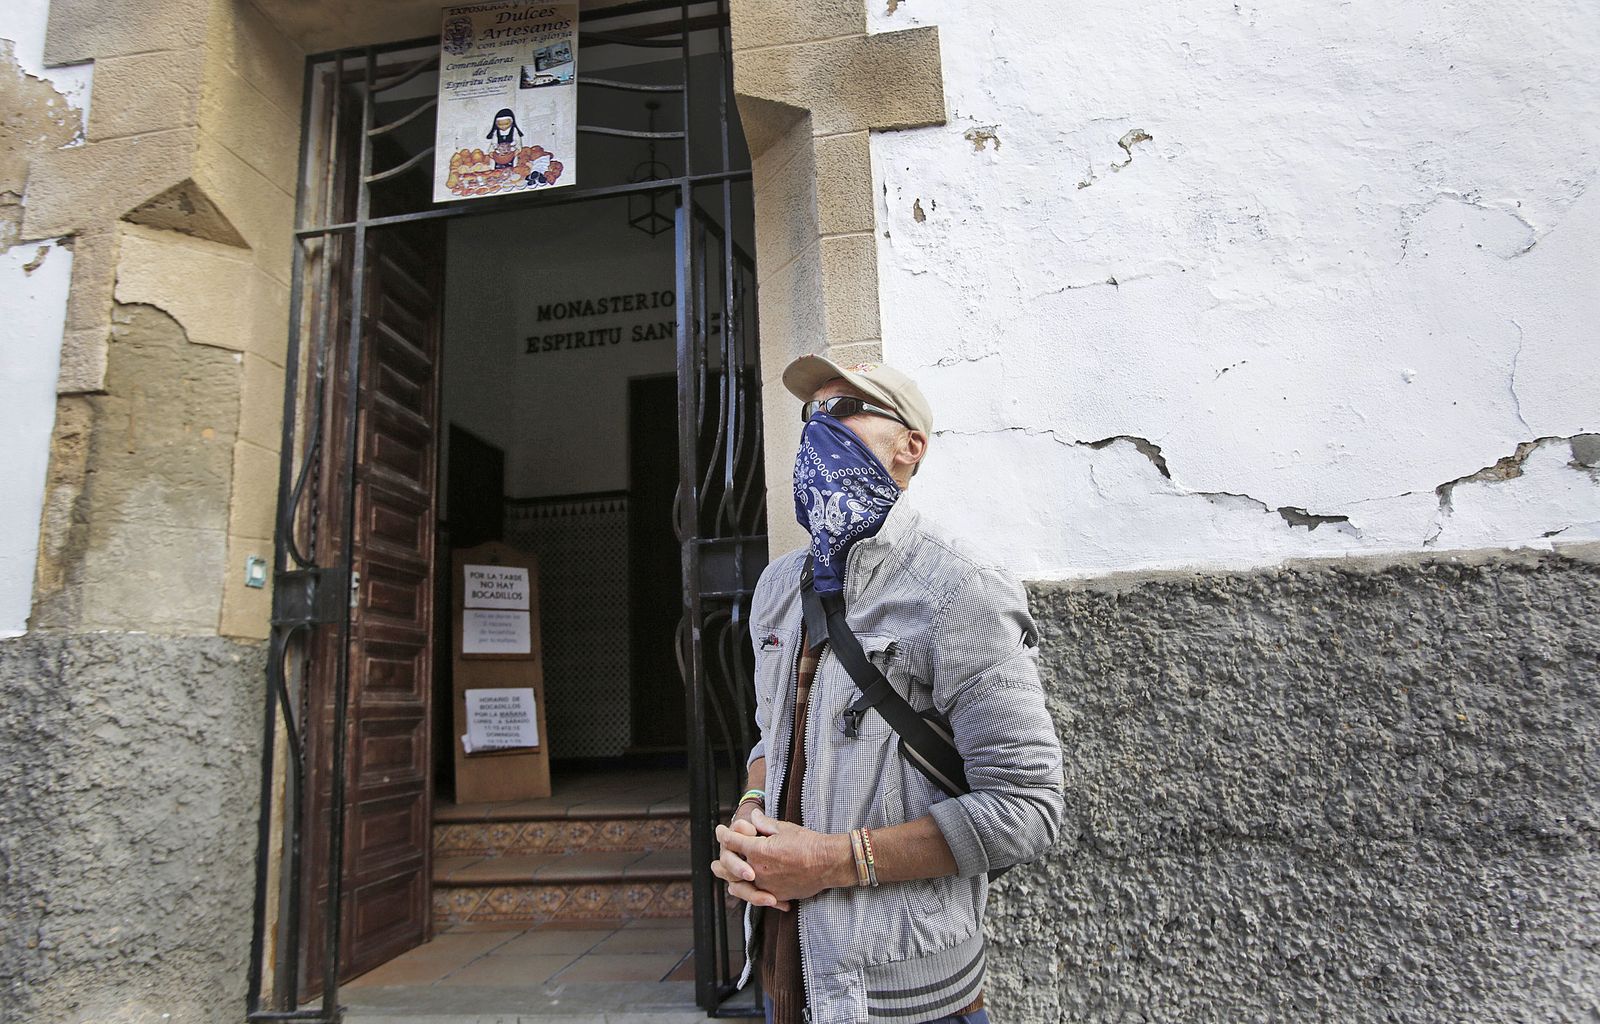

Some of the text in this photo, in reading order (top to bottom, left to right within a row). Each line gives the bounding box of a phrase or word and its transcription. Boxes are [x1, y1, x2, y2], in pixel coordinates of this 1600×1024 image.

[496, 7, 557, 24] Dulces
[479, 20, 572, 41] Artesanos
[478, 42, 496, 50] con
[499, 37, 529, 47] sabor
[538, 31, 573, 44] gloria
[446, 55, 515, 71] Comendadoras
[472, 67, 488, 77] del
[485, 74, 514, 86] Santo
[536, 290, 676, 322] MONASTERIO
[525, 327, 623, 354] ESPIRITU
[470, 571, 522, 582] POR LA TARDE
[480, 580, 514, 590] NO HAY
[472, 590, 523, 600] BOCADILLOS
